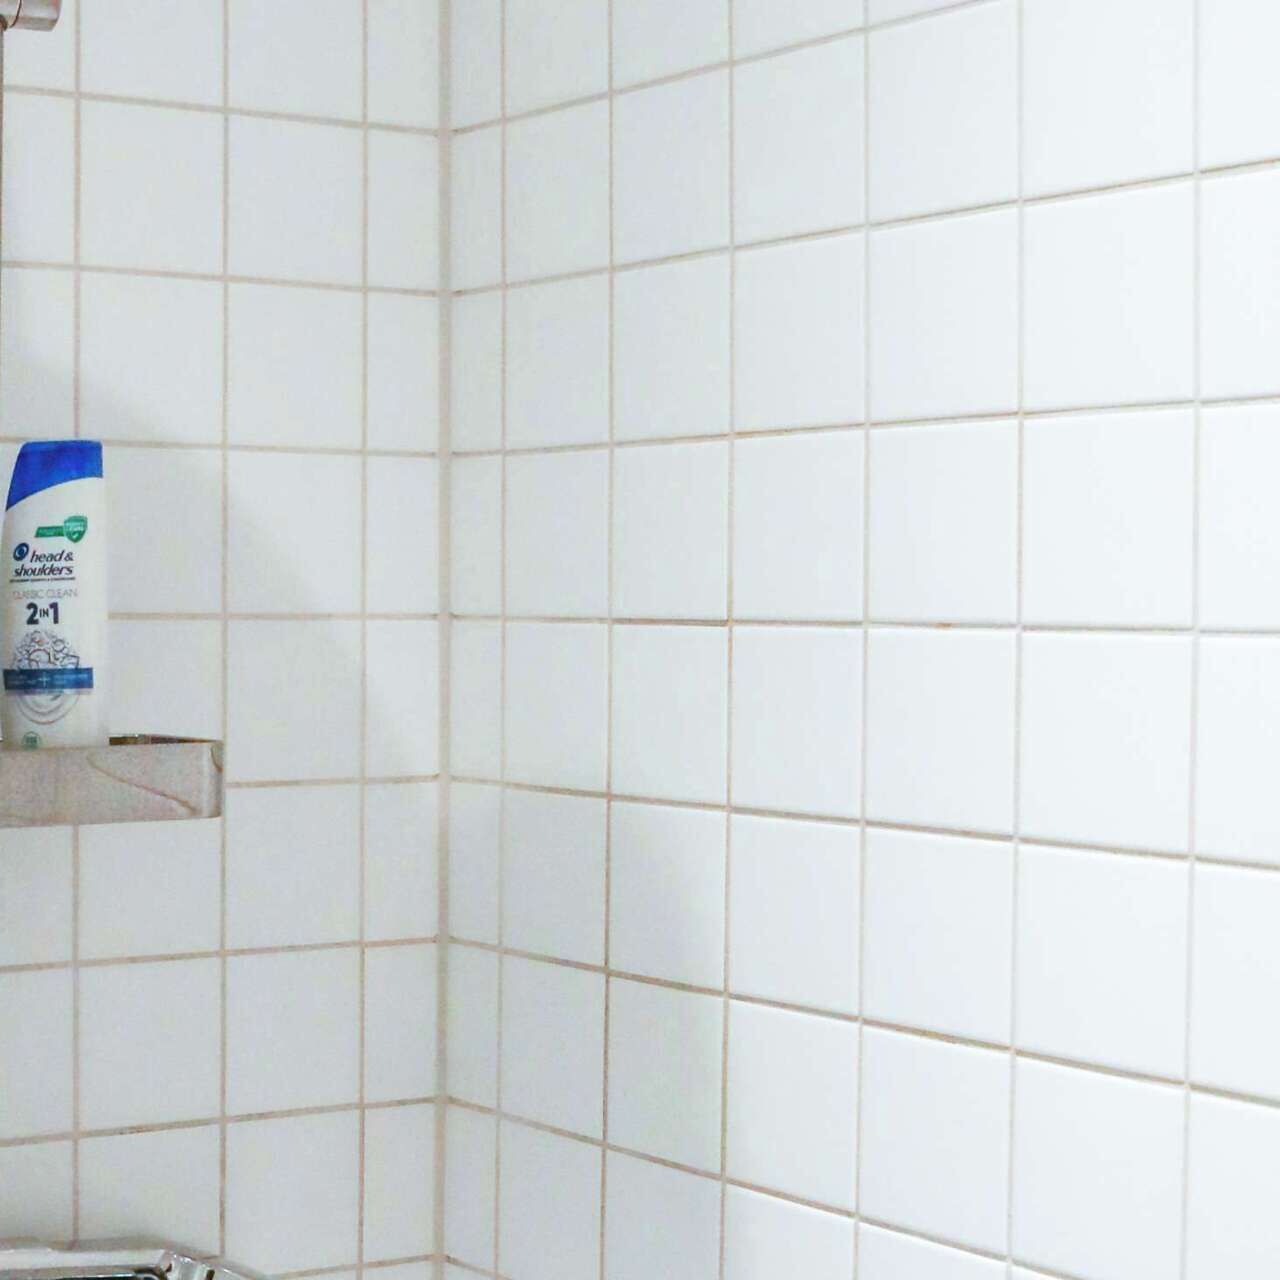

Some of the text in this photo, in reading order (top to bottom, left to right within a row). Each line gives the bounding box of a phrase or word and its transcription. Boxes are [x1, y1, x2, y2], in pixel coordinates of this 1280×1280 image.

[30, 549, 73, 563] head &
[14, 564, 73, 577] shoulders
